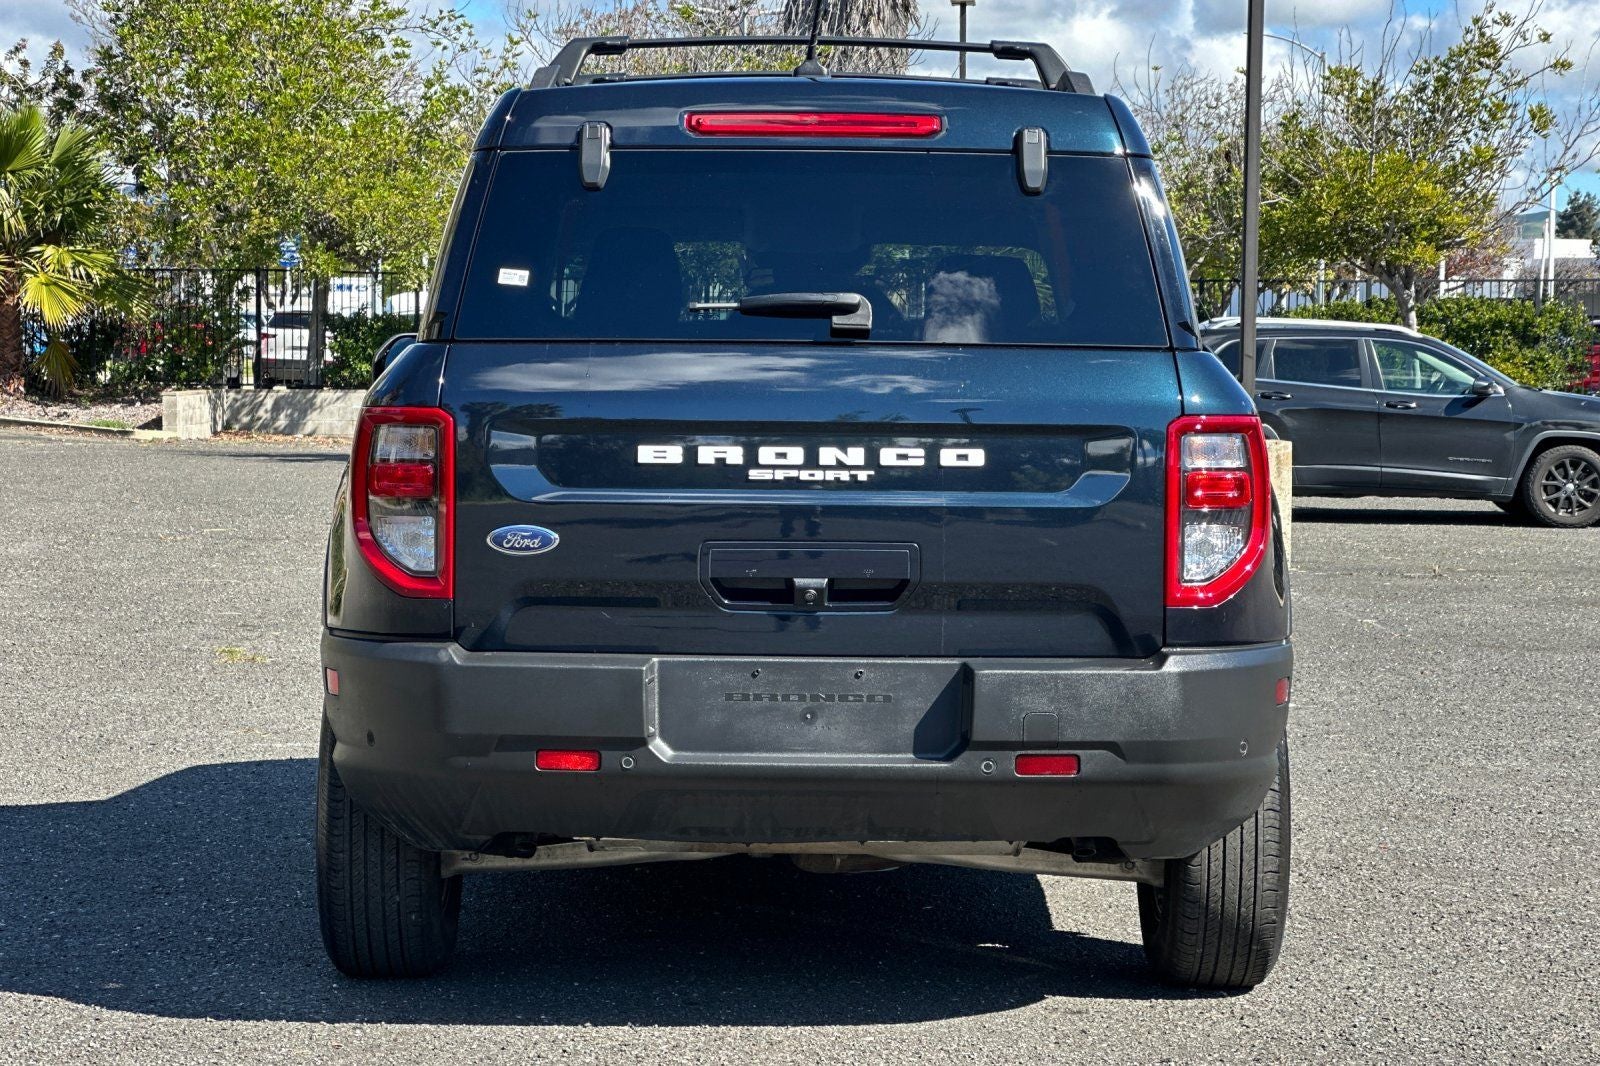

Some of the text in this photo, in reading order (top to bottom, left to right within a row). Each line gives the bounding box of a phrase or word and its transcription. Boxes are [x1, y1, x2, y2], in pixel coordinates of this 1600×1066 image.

[637, 445, 985, 467] BRONCO
[748, 469, 875, 481] SPORT
[503, 531, 542, 548] Ford
[724, 692, 893, 703] BRONCO
